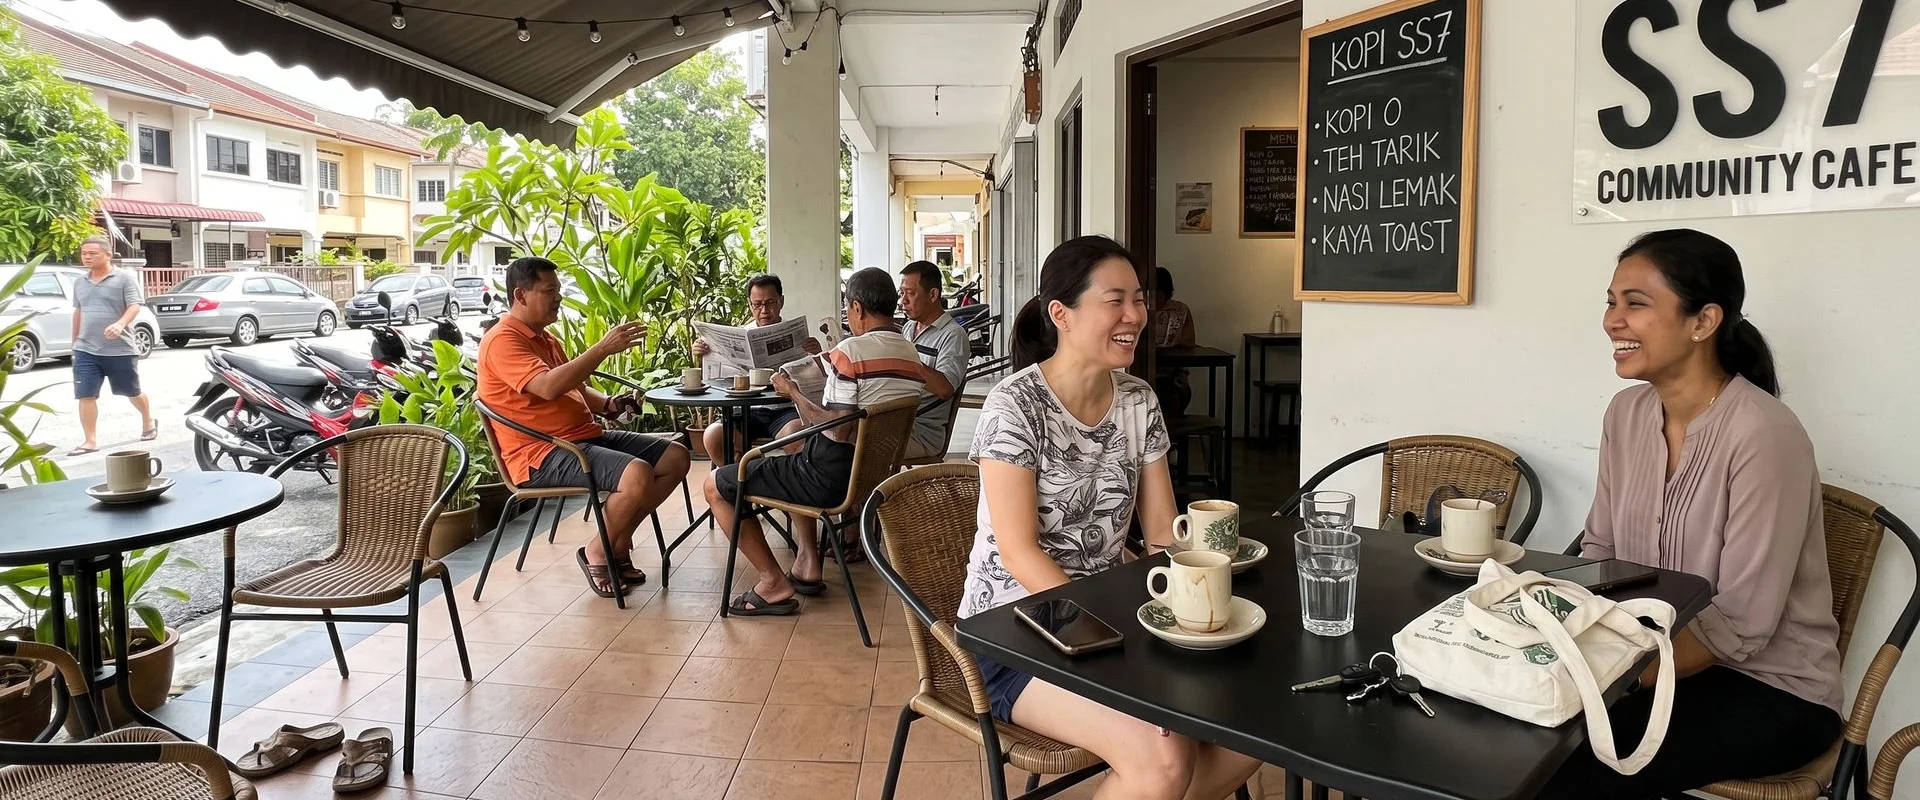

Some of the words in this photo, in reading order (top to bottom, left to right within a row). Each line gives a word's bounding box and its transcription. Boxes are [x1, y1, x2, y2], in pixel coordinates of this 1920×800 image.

[1331, 29, 1385, 77] KOPI
[1398, 10, 1453, 60] SS7
[1325, 102, 1371, 138] KOPI
[1384, 97, 1401, 127] O
[1323, 143, 1363, 173] TEH
[1371, 131, 1440, 168] TARIK
[1598, 152, 1803, 204] COMMUNITY
[1812, 141, 1917, 190] CAFE
[1323, 181, 1369, 214] NASI
[1380, 172, 1457, 209] LEMAK
[1323, 224, 1373, 255] KAYA
[1380, 218, 1452, 254] TOAST
